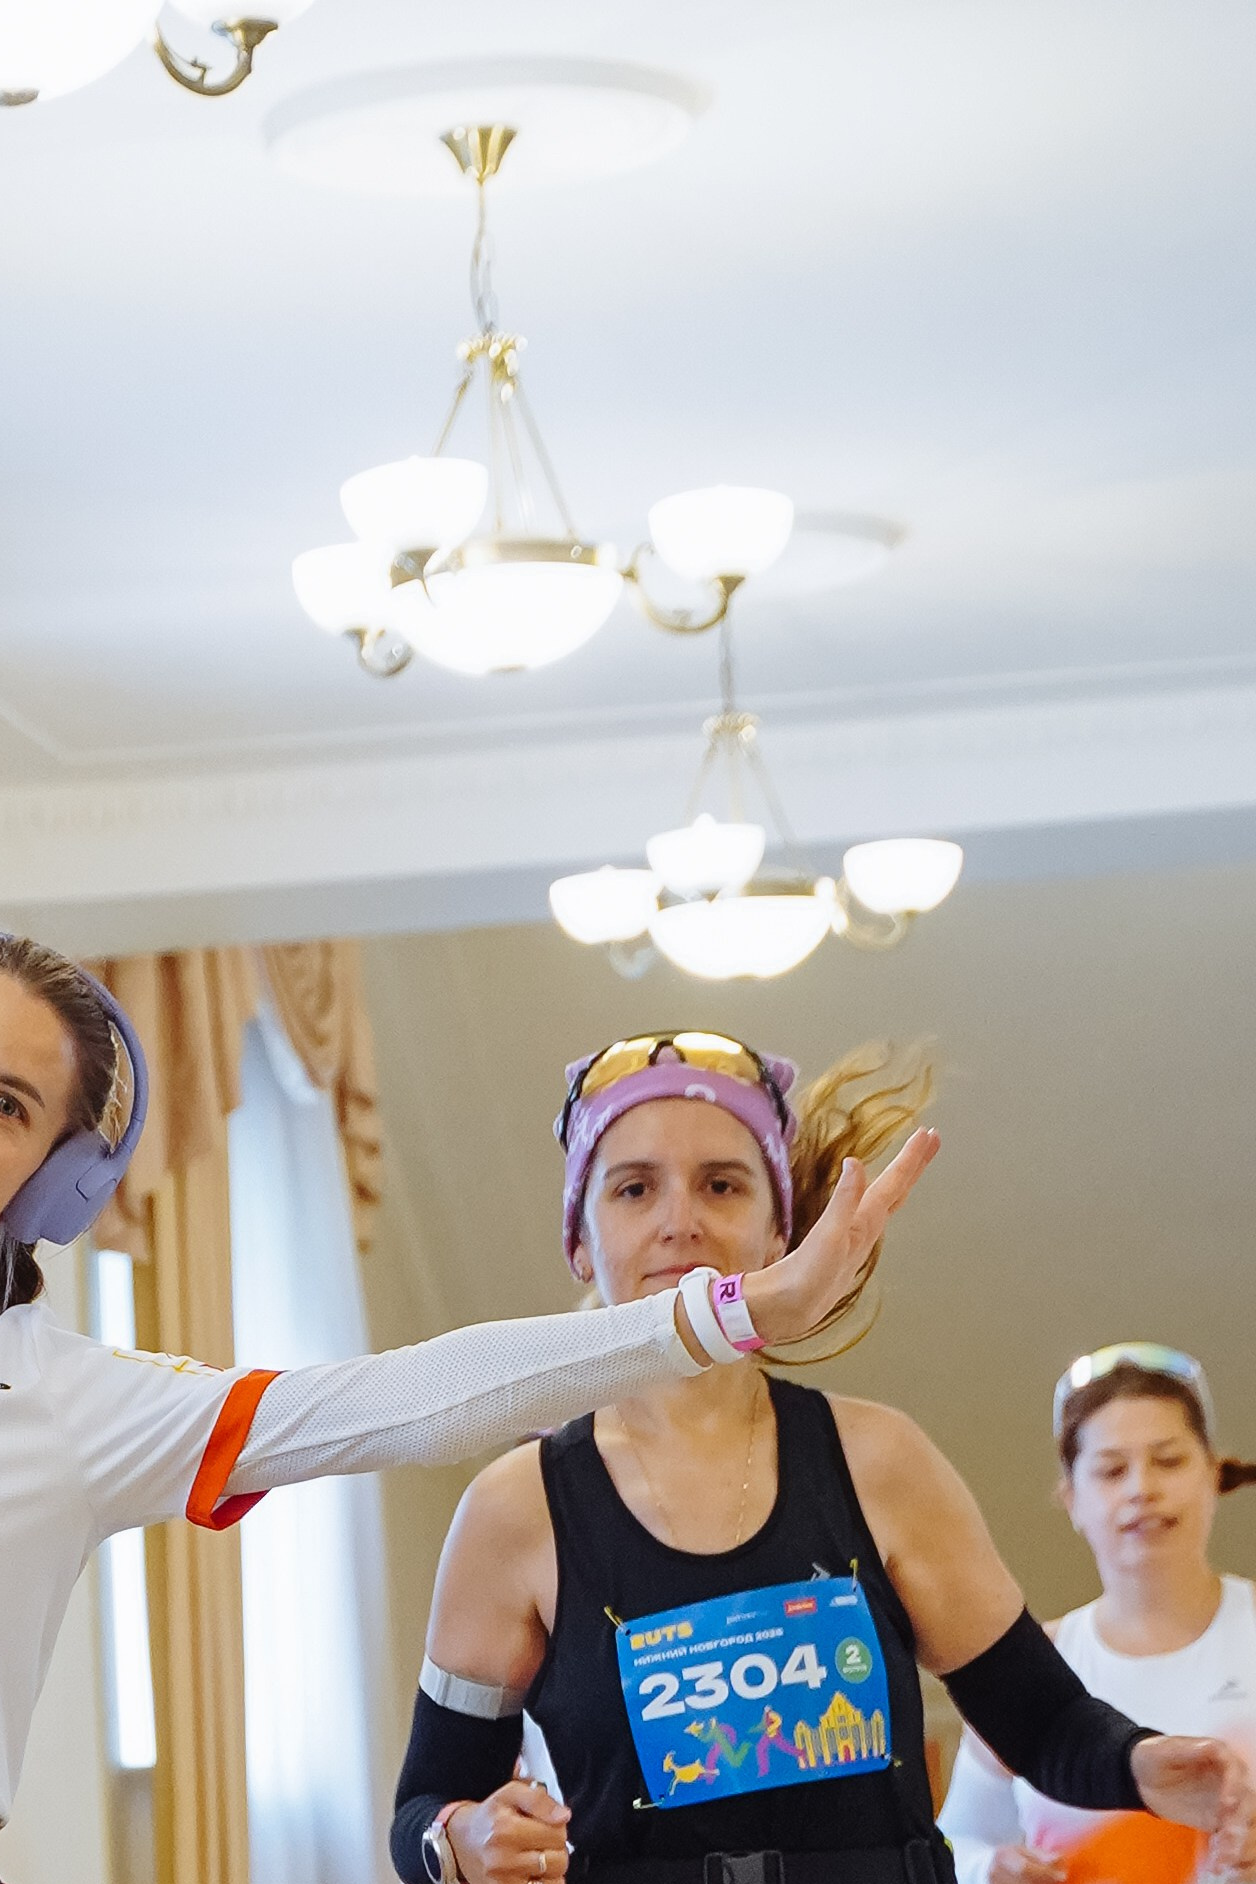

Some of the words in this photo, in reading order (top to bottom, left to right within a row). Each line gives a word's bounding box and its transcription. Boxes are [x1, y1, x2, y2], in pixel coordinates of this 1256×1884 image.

[634, 1647, 687, 1667] НИЖНИЙ
[688, 1632, 754, 1655] НОВГОРОД
[845, 1644, 861, 1665] 2
[638, 1644, 827, 1722] 2304
